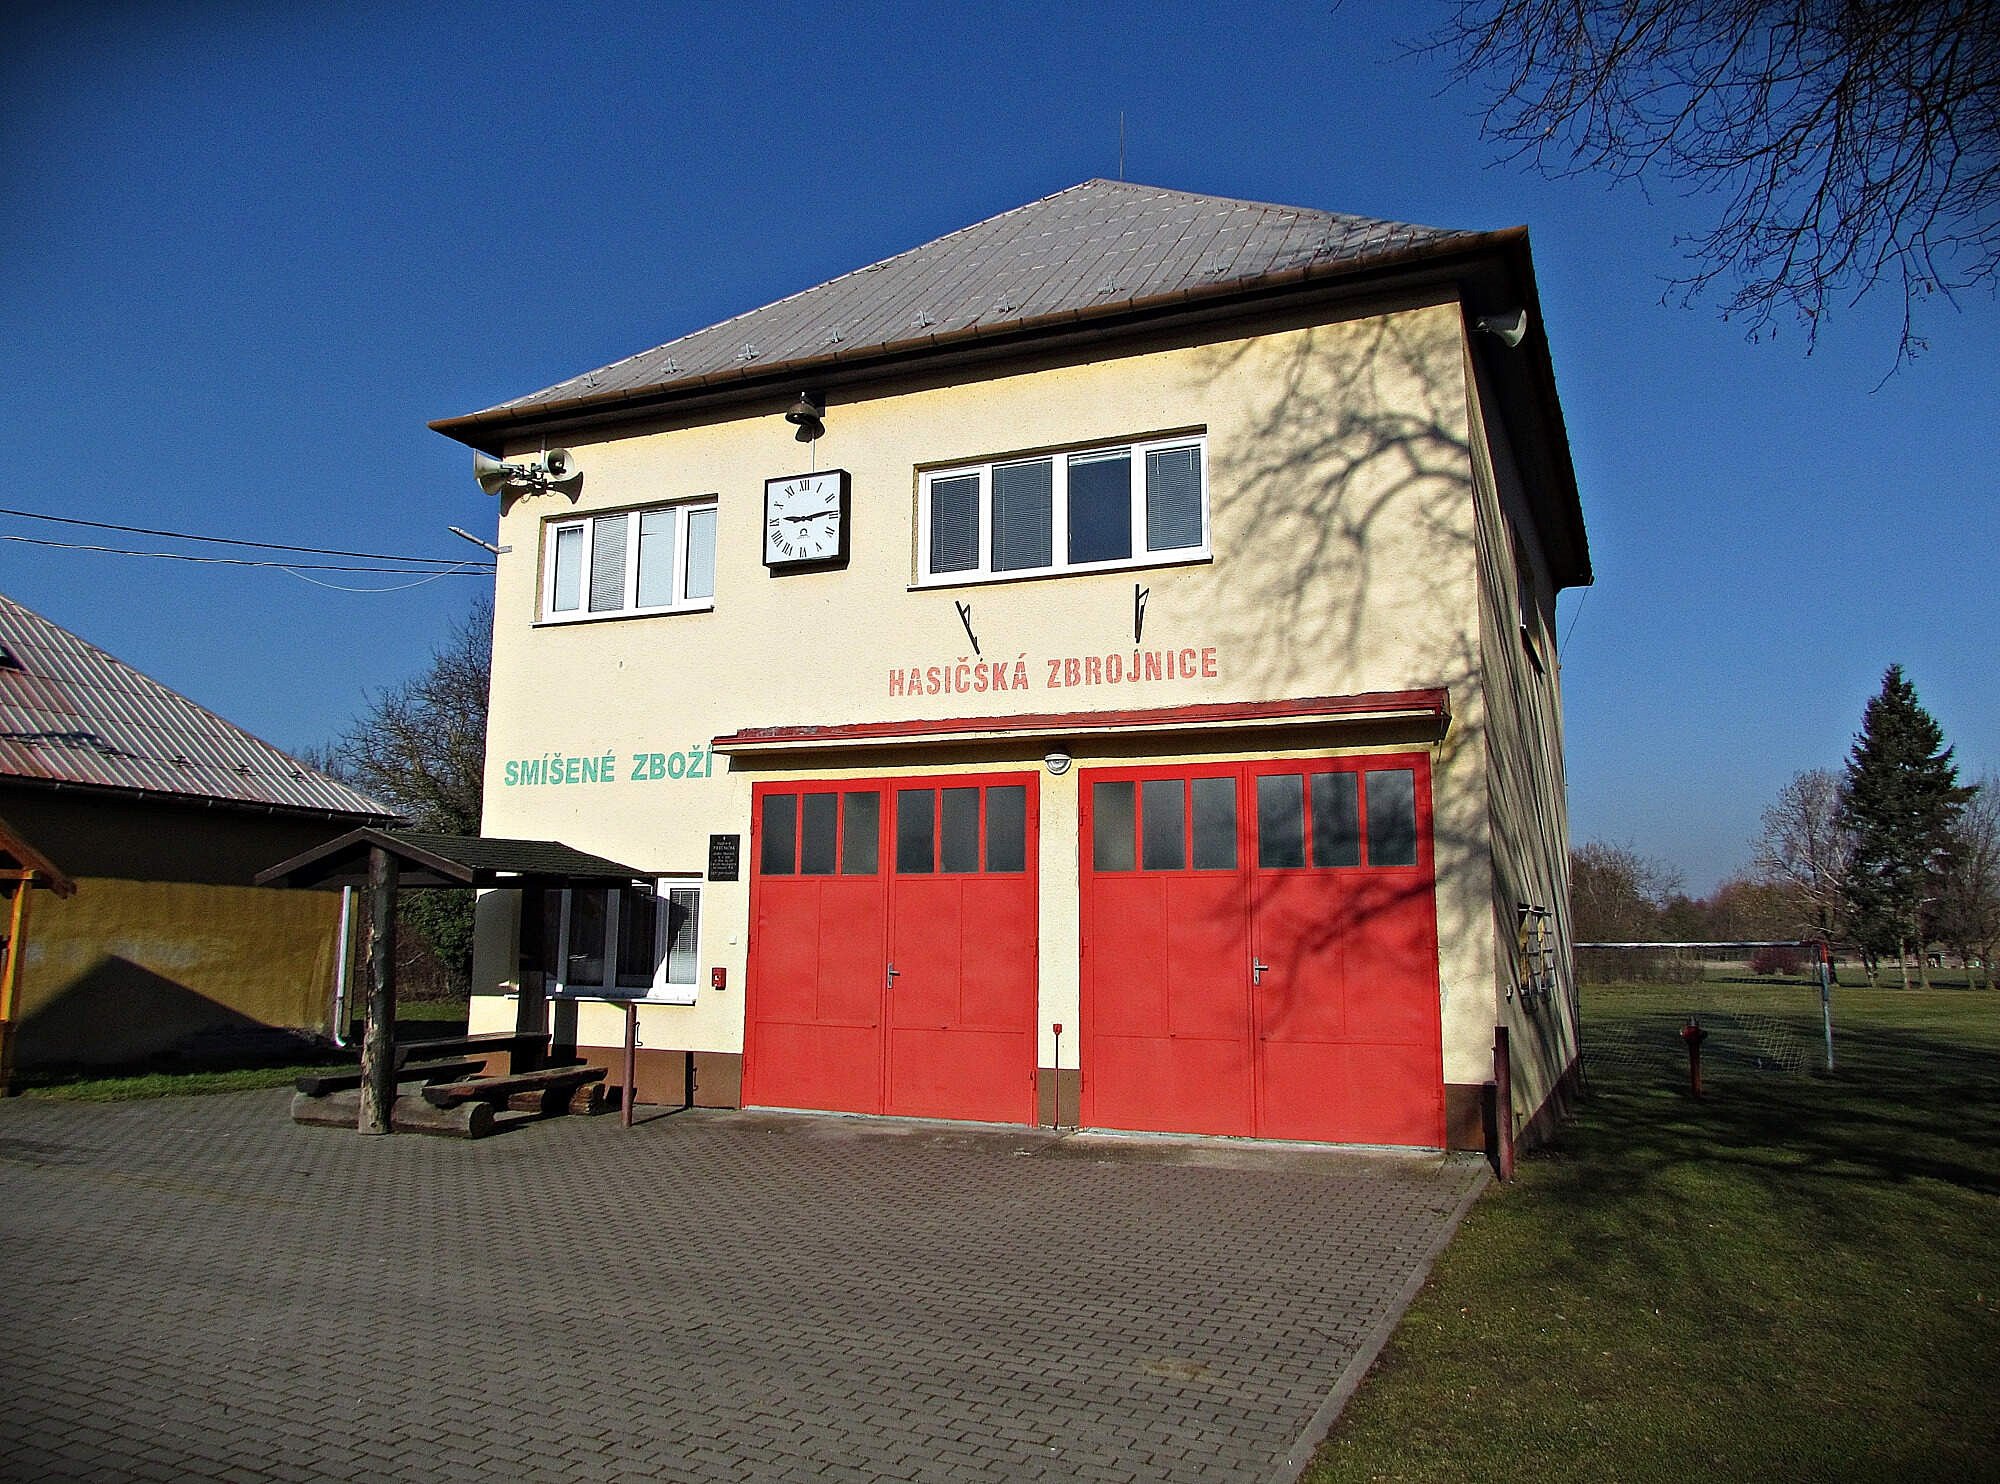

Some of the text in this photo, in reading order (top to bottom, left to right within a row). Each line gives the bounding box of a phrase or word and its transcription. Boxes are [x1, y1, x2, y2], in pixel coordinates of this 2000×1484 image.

[799, 479, 810, 491] XII
[784, 485, 795, 498] XI
[825, 493, 835, 503] II
[774, 501, 784, 510] X
[769, 518, 779, 527] IX
[825, 526, 835, 537] IV
[782, 542, 793, 556] VII
[799, 546, 807, 557] VI
[815, 542, 822, 552] V
[889, 647, 1217, 697] HASIČSKÁ ZBROJNICE
[504, 744, 712, 786] SMÍŠENÉ ZBOŽÍ
